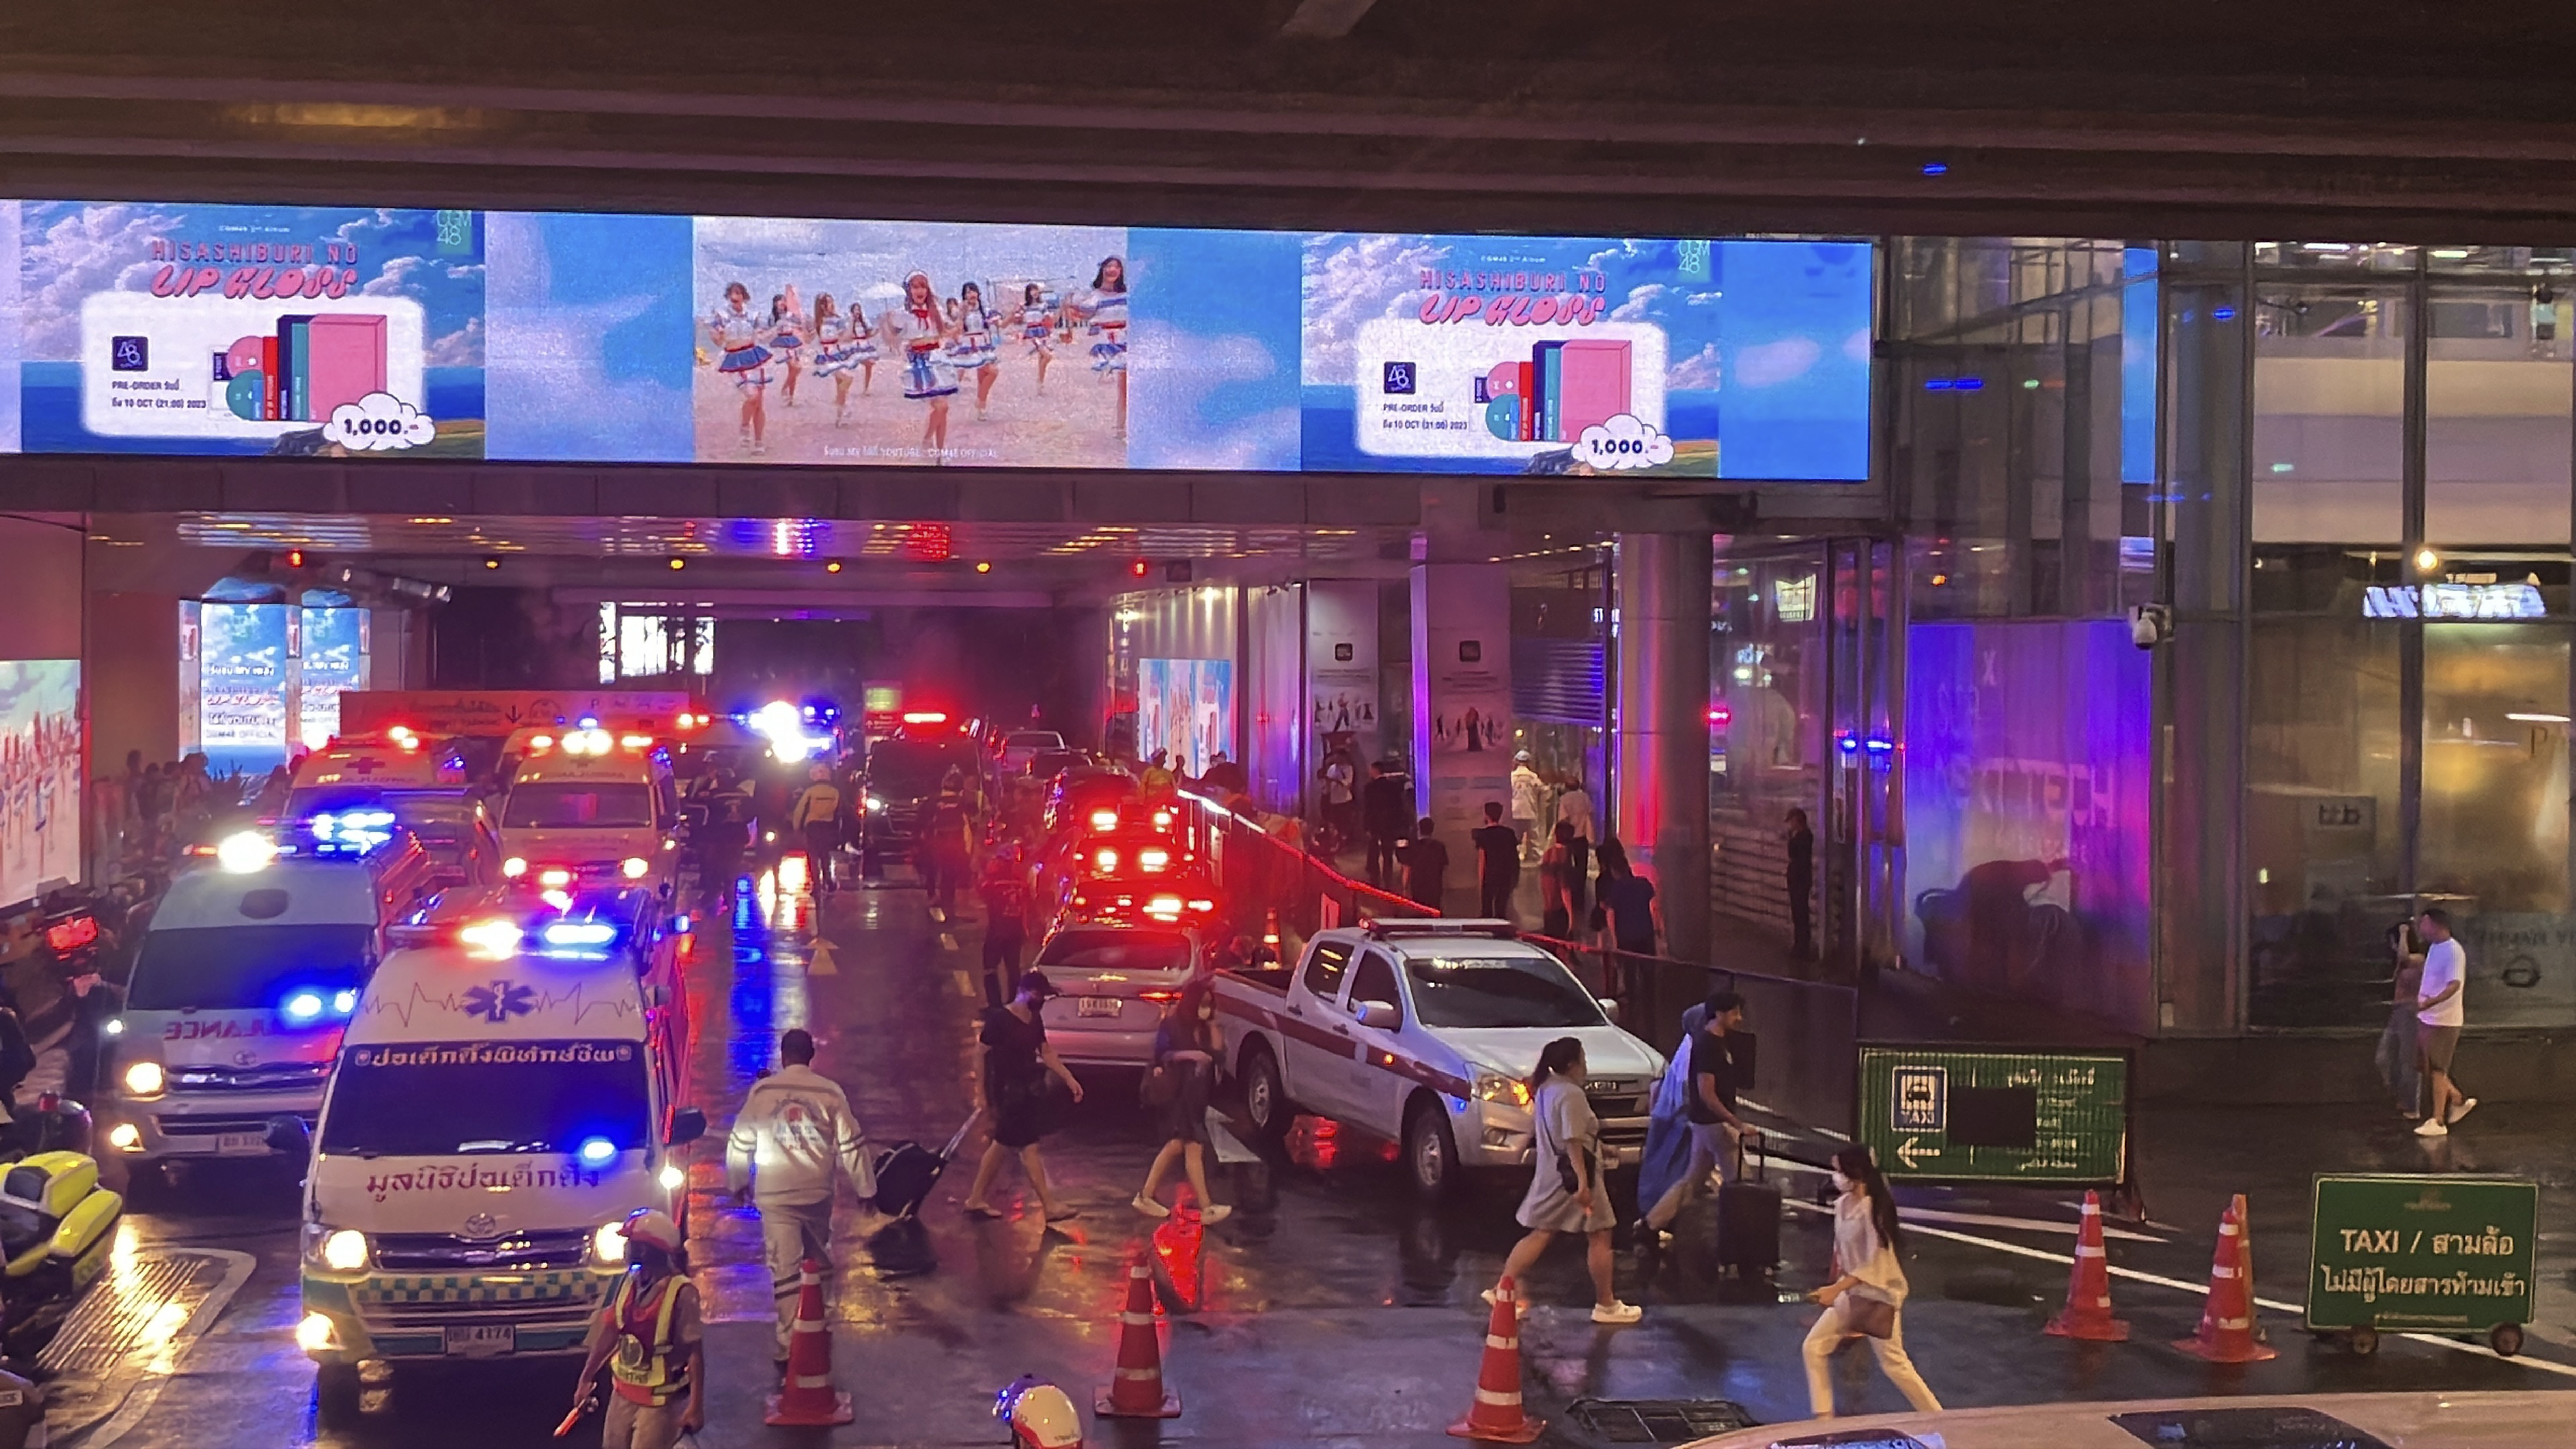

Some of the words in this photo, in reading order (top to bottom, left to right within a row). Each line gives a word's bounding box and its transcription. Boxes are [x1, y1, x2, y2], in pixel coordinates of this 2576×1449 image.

[437, 226, 461, 246] 48
[152, 240, 313, 263] HISASHIBURI
[327, 242, 357, 264] NO
[1678, 255, 1700, 274] 48
[151, 264, 220, 298] LIP
[224, 266, 358, 300] GLOSS
[1420, 269, 1565, 292] HISASHIBURI
[1579, 272, 1606, 293] NO
[1419, 293, 1482, 325] LIP
[1484, 295, 1606, 326] GLOSS
[112, 381, 162, 390] PRE-ORDER
[137, 399, 154, 408] OCT
[1383, 403, 1428, 412] PRE-ORDER
[1405, 420, 1420, 429] OCT
[1450, 421, 1468, 430] 2023
[2340, 1229, 2400, 1254] TAXI
[2410, 1230, 2423, 1254] /
[2432, 1225, 2514, 1256] สามล้อ
